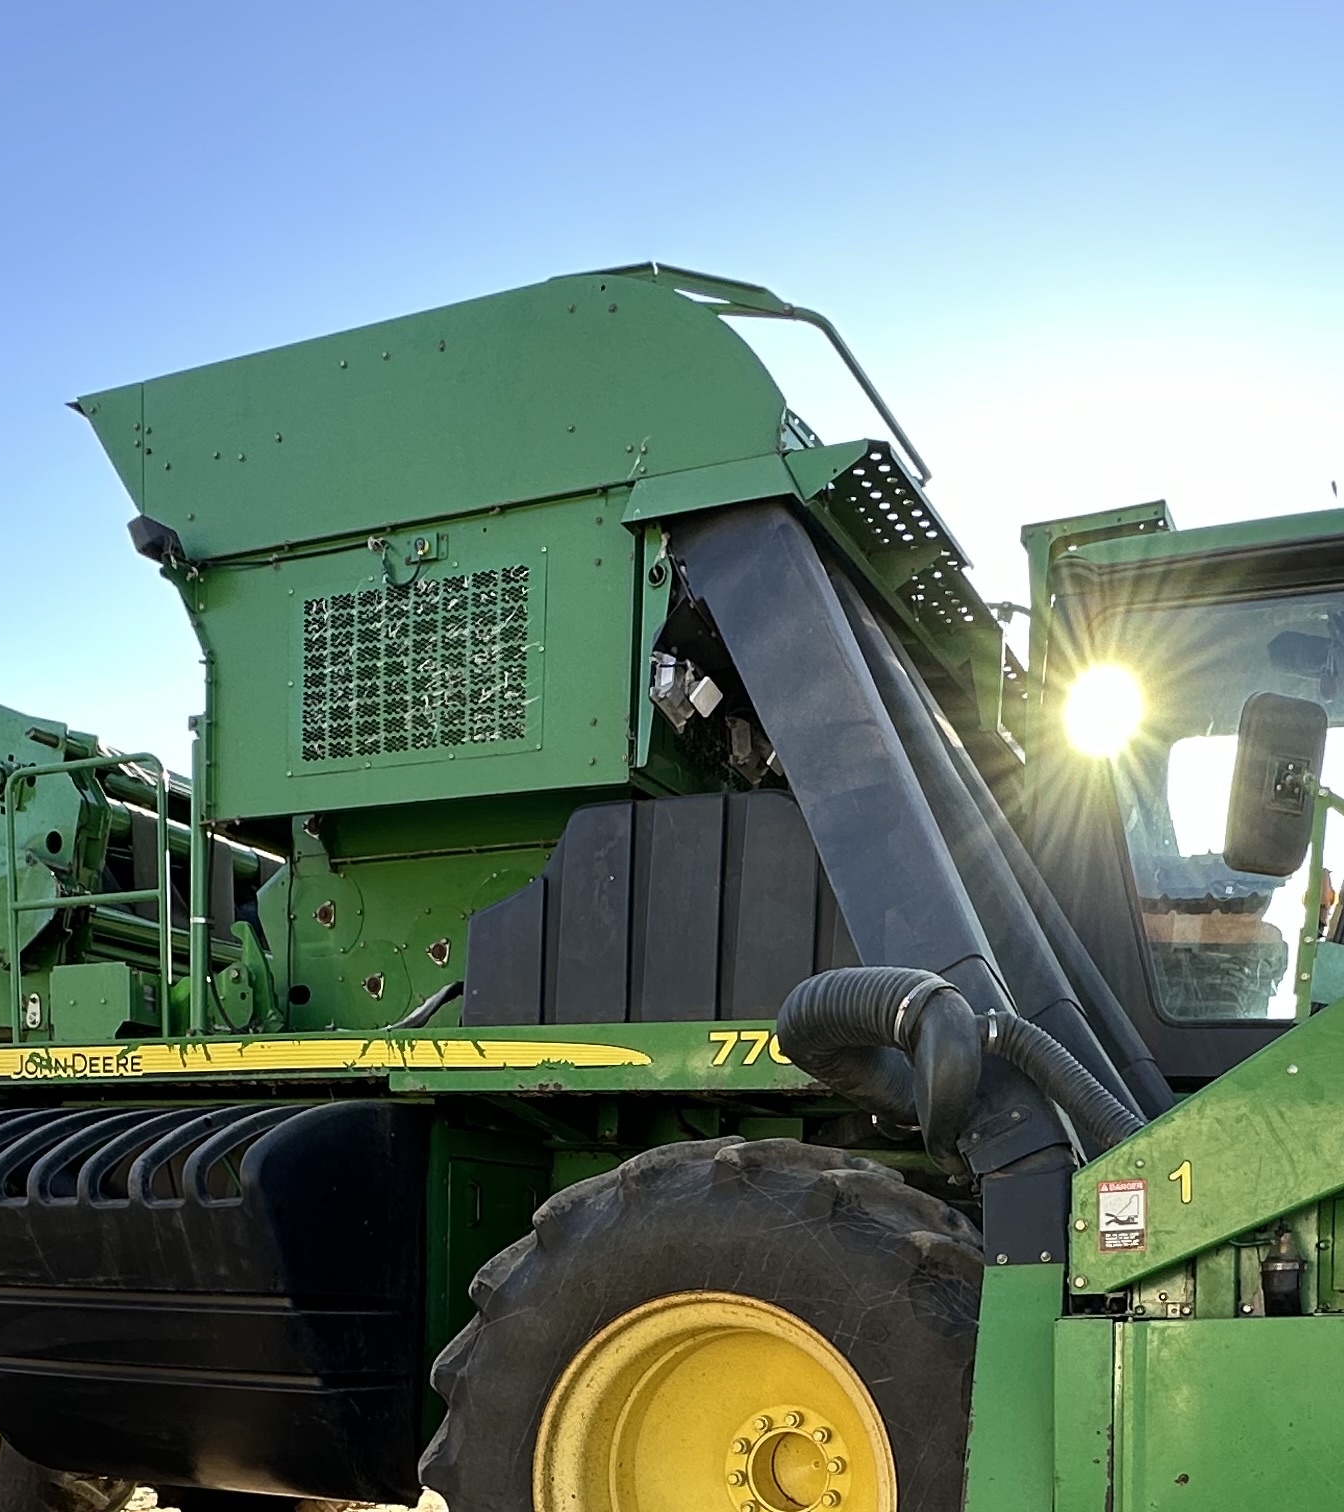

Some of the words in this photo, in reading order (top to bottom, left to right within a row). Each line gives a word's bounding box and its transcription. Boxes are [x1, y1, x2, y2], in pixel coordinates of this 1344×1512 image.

[72, 1052, 143, 1075] DEERE
[1109, 1181, 1143, 1191] DANGER
[1168, 1160, 1192, 1205] 1
